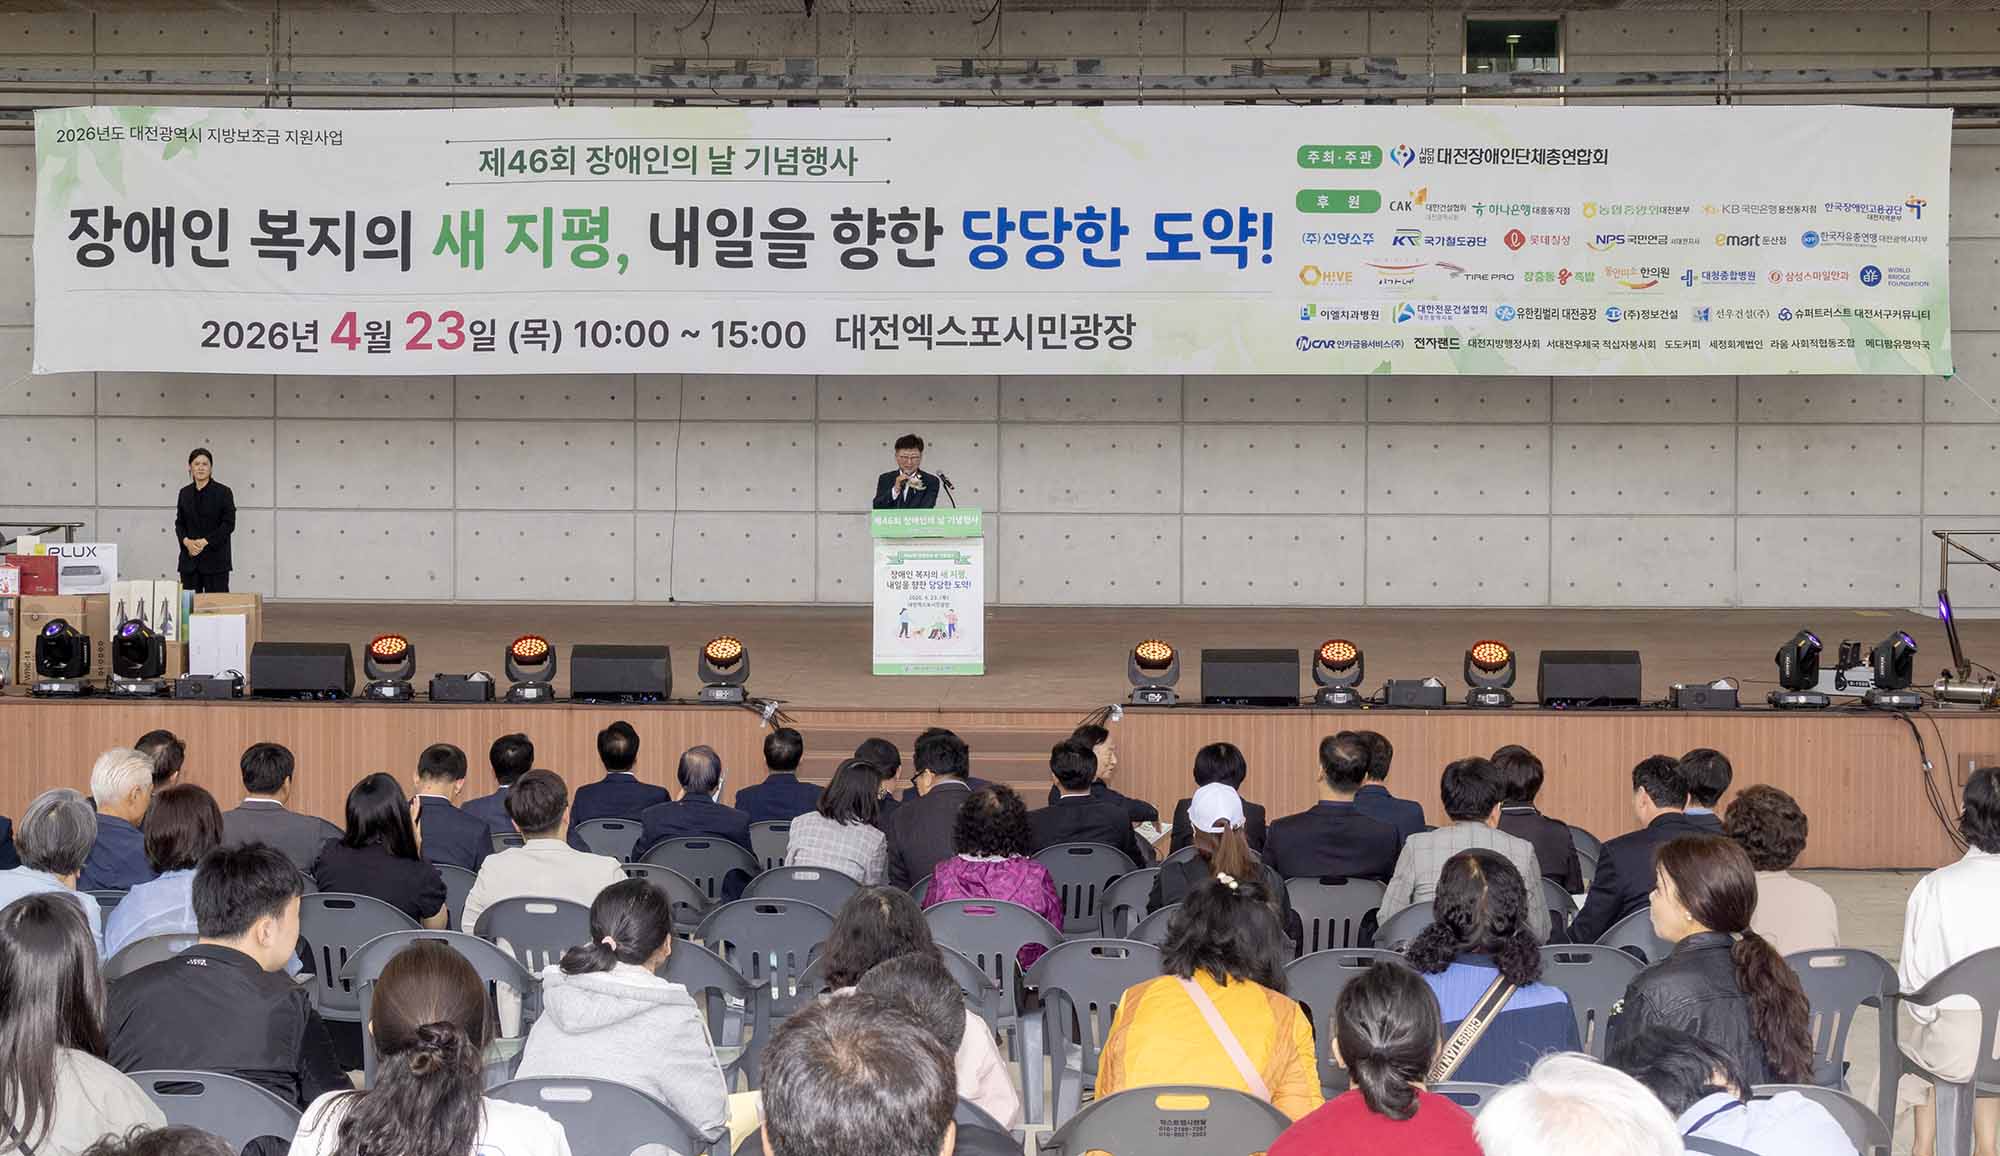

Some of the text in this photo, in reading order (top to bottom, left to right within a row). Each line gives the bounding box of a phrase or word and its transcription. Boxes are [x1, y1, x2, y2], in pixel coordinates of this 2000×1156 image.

[56, 126, 343, 146] 2026년도 대전광역시 지방보조금 지원사업
[479, 145, 857, 177] 제46회 장애인의 날 기념행사
[1437, 147, 1609, 166] 대전장애인단체총연합회
[1389, 201, 1412, 212] CAK
[1825, 202, 1902, 216] 한국장애인고용공단
[68, 205, 1272, 275] 장애인 복지의 새 지평, 내일을 향한 당당한 도약!
[1424, 236, 1487, 247] 국가철도공단
[1596, 234, 1625, 245] NPS
[1627, 234, 1668, 246] 국민연금
[1715, 233, 1760, 247] emart
[1821, 231, 1877, 244] 한국자유총연맹
[1464, 273, 1514, 281] TIRE PRO
[1702, 270, 1756, 282] 대청종합병원
[1320, 309, 1379, 321] 이엘치과병원
[1417, 304, 1488, 315] 대한전문건설협회
[1516, 308, 1597, 320] 유한킴벌리 대전공장
[1623, 309, 1678, 321] (주)정보건설
[1795, 308, 1930, 321] 슈퍼트러스트 대전서구커뮤니티
[201, 319, 319, 353] 2026년
[330, 311, 392, 354] 4월
[404, 310, 497, 353] 23일
[508, 320, 562, 353] (목)
[575, 320, 668, 349] 10:00
[711, 320, 806, 349] 15:00
[835, 314, 1136, 352] 대전엑스포시민광장
[1414, 337, 1460, 350] 전자랜드
[1468, 338, 1540, 350] 대전지방행정사회
[1546, 339, 1656, 350] 서대전우체국 적십자봉사회
[1665, 339, 1701, 350] 도도커피
[1709, 339, 1763, 350] 세정회계법인
[1791, 338, 1855, 350] 사회적협동조합
[1441, 1016, 1483, 1068] CHRISTIAN
